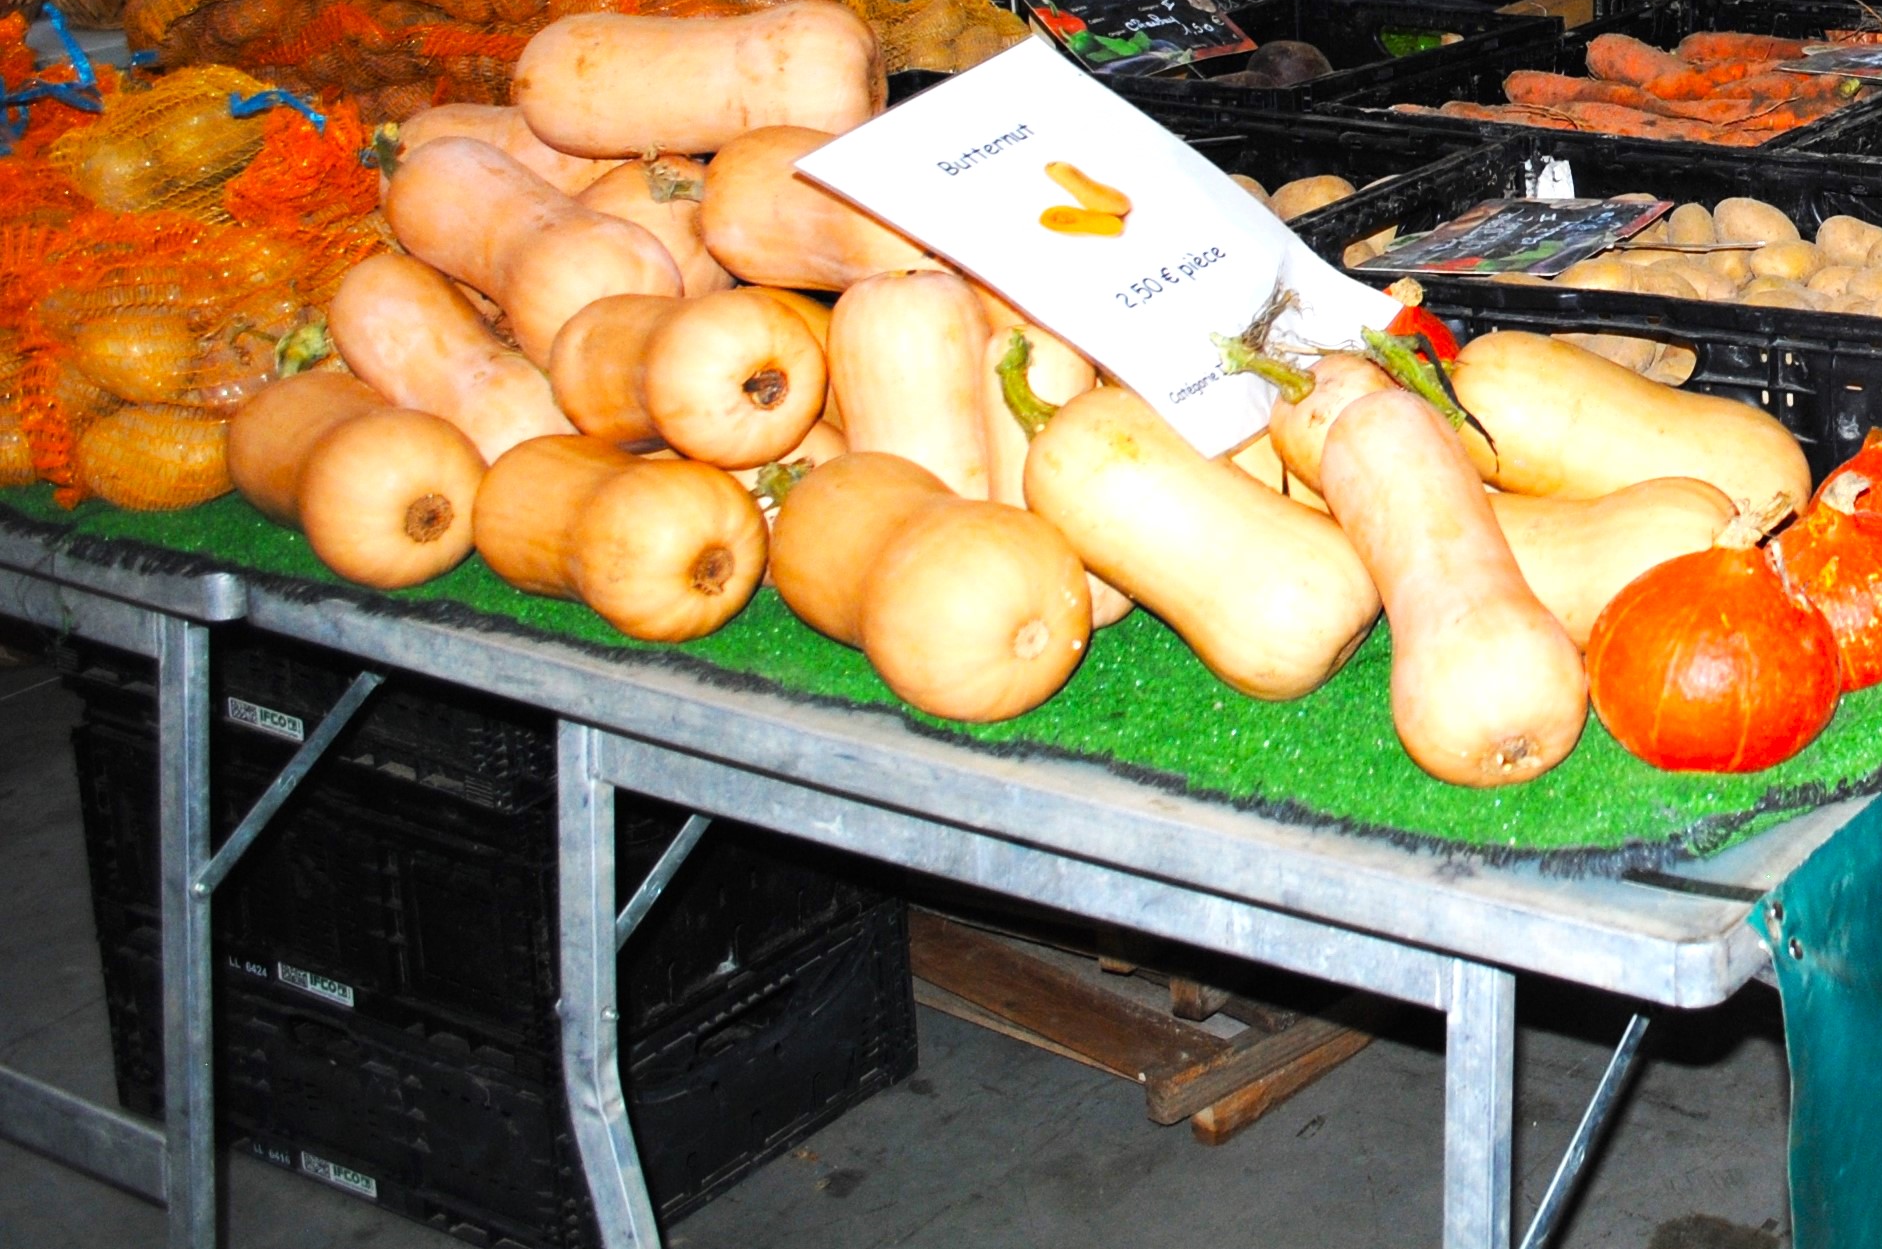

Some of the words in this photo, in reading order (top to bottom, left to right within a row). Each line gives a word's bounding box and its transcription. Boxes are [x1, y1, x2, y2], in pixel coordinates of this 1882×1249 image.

[937, 122, 1036, 178] Butternut
[1114, 275, 1164, 312] 2,50
[1158, 266, 1180, 287] €
[1178, 243, 1228, 281] pièce
[260, 709, 286, 728] IFCO
[310, 974, 336, 993] IFCO
[333, 1164, 360, 1184] IFCO
